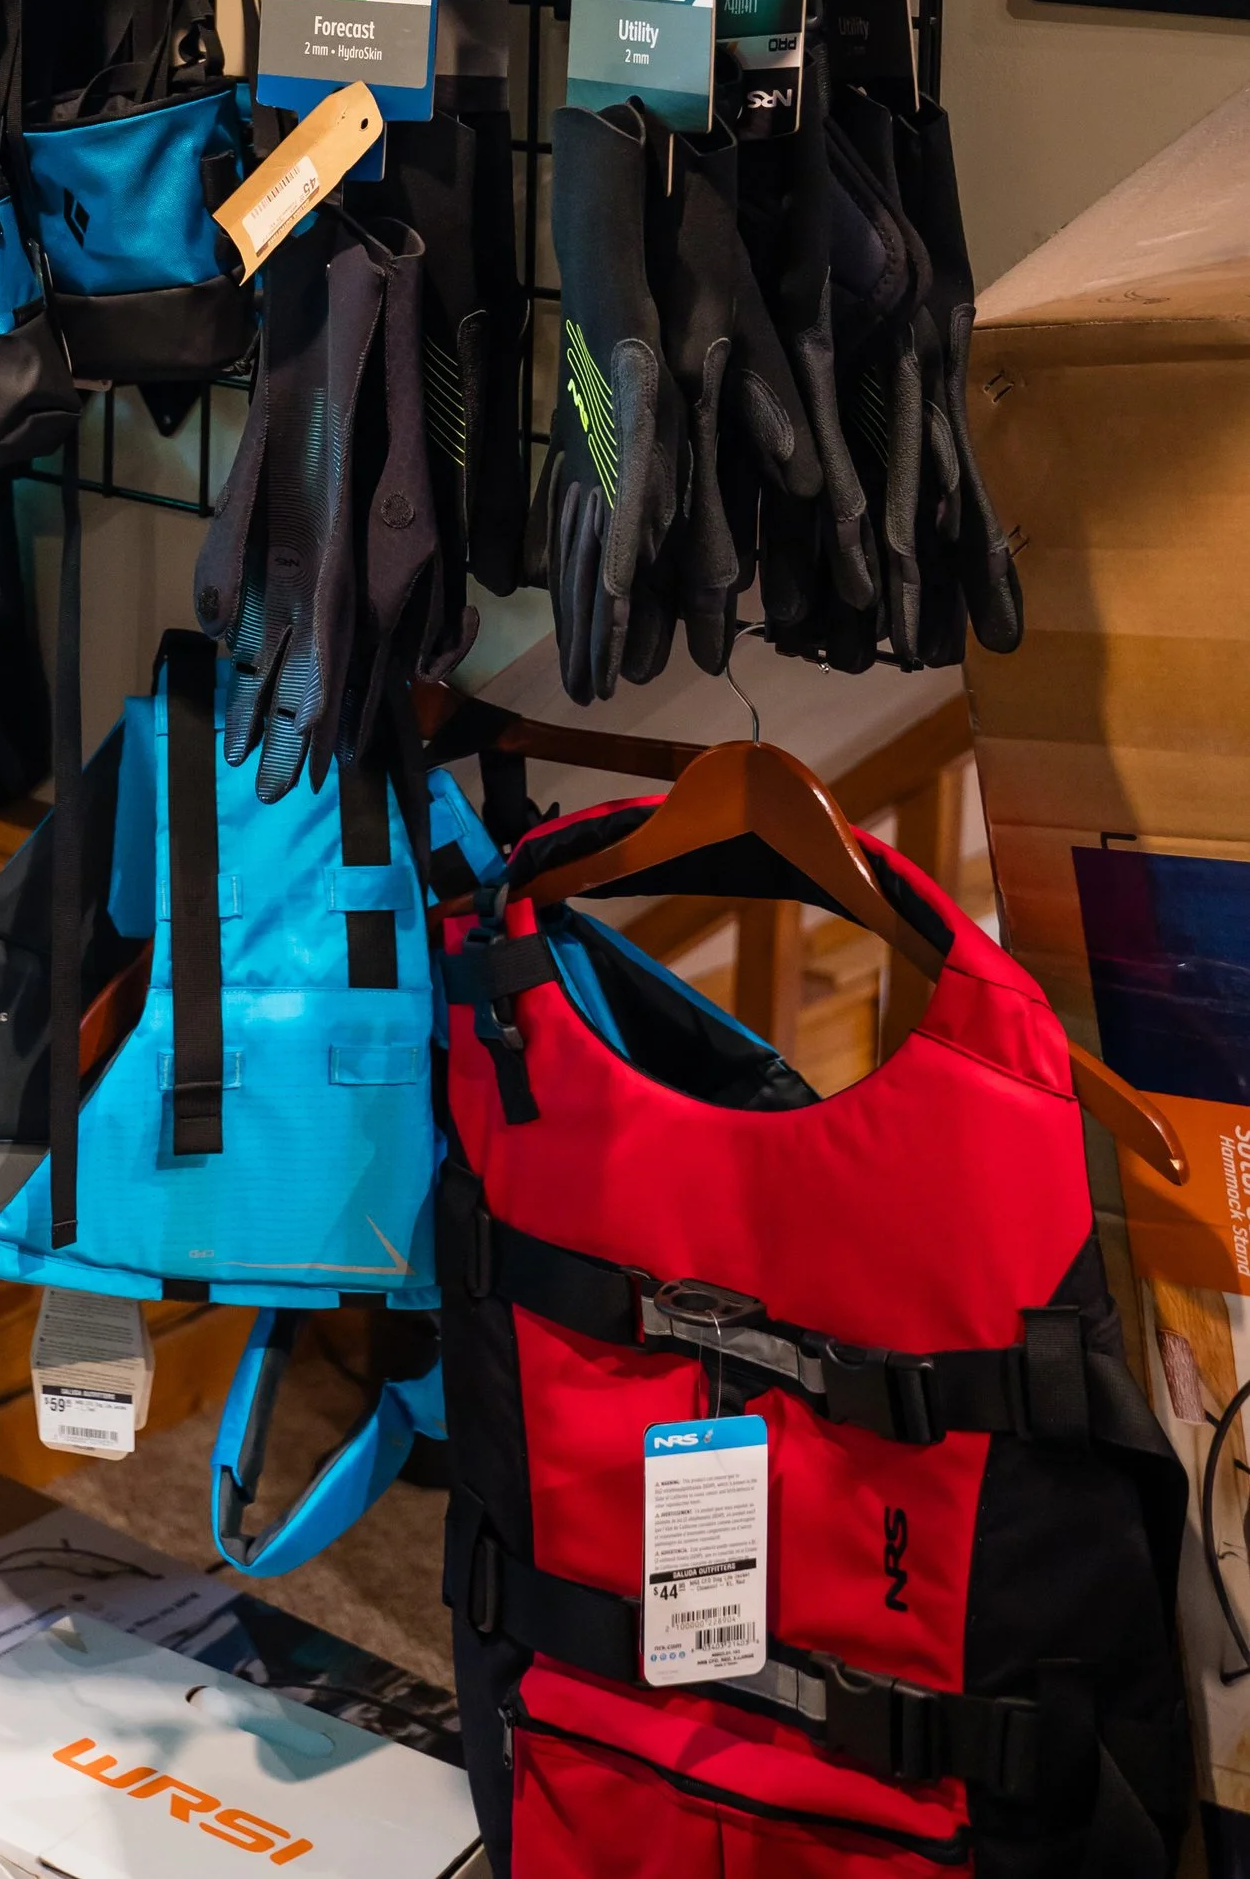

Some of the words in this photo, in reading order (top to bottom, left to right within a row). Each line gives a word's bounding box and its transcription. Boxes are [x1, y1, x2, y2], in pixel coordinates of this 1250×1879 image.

[314, 15, 376, 40] Forecast
[618, 19, 659, 48] Utility
[304, 42, 311, 55] 2
[312, 45, 329, 56] mm
[338, 45, 383, 61] HydroSkin
[768, 37, 797, 53] PRO
[625, 49, 631, 63] 2
[633, 53, 650, 65] mm
[748, 88, 793, 108] NRS
[1219, 1133, 1246, 1222] Hammock
[1233, 1225, 1250, 1276] Stand
[654, 1433, 699, 1449] NRS
[884, 1506, 908, 1612] NRS
[672, 1567, 698, 1579] SALUDA
[698, 1562, 736, 1576] OUTFITTERS
[52, 1736, 315, 1866] WRSI
